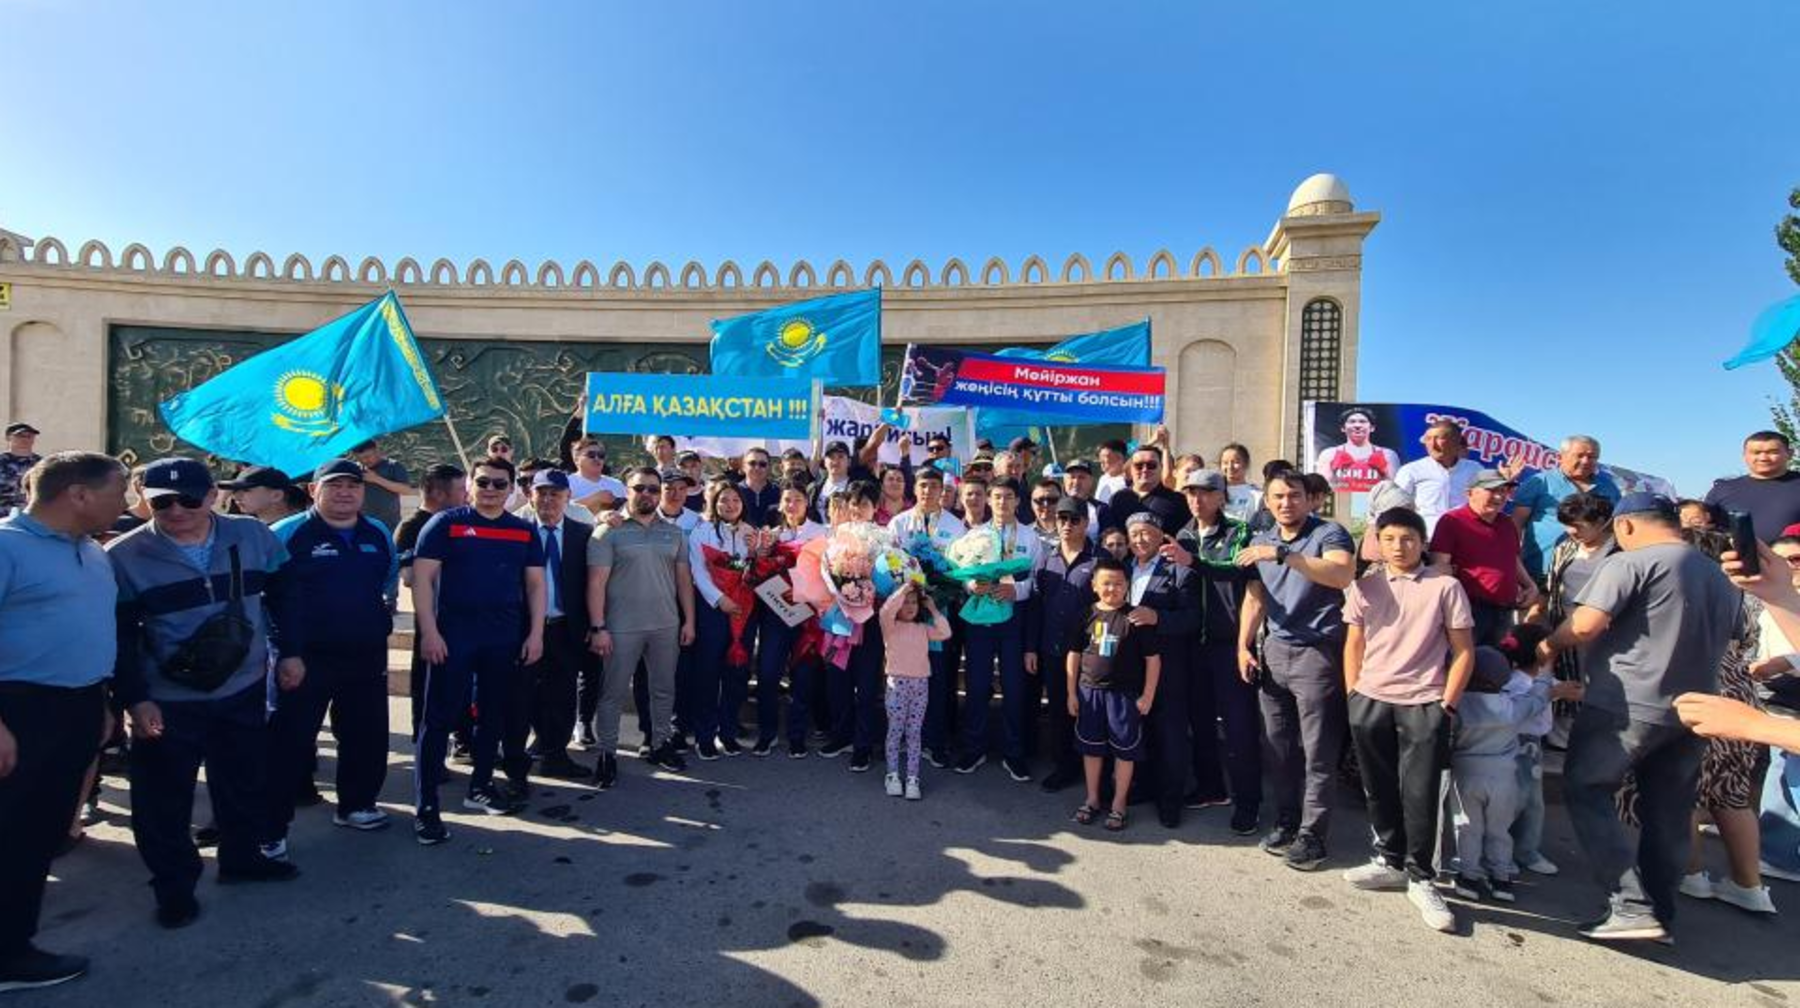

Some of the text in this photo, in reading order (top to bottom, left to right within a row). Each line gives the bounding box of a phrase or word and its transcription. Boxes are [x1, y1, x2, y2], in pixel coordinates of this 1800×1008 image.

[1014, 366, 1100, 387] Мейіржан
[591, 393, 808, 420] АЛҒА ҚАЗАҚСТАН !!!
[954, 379, 1019, 399] жеңісің
[1077, 391, 1160, 409] болсын!!!
